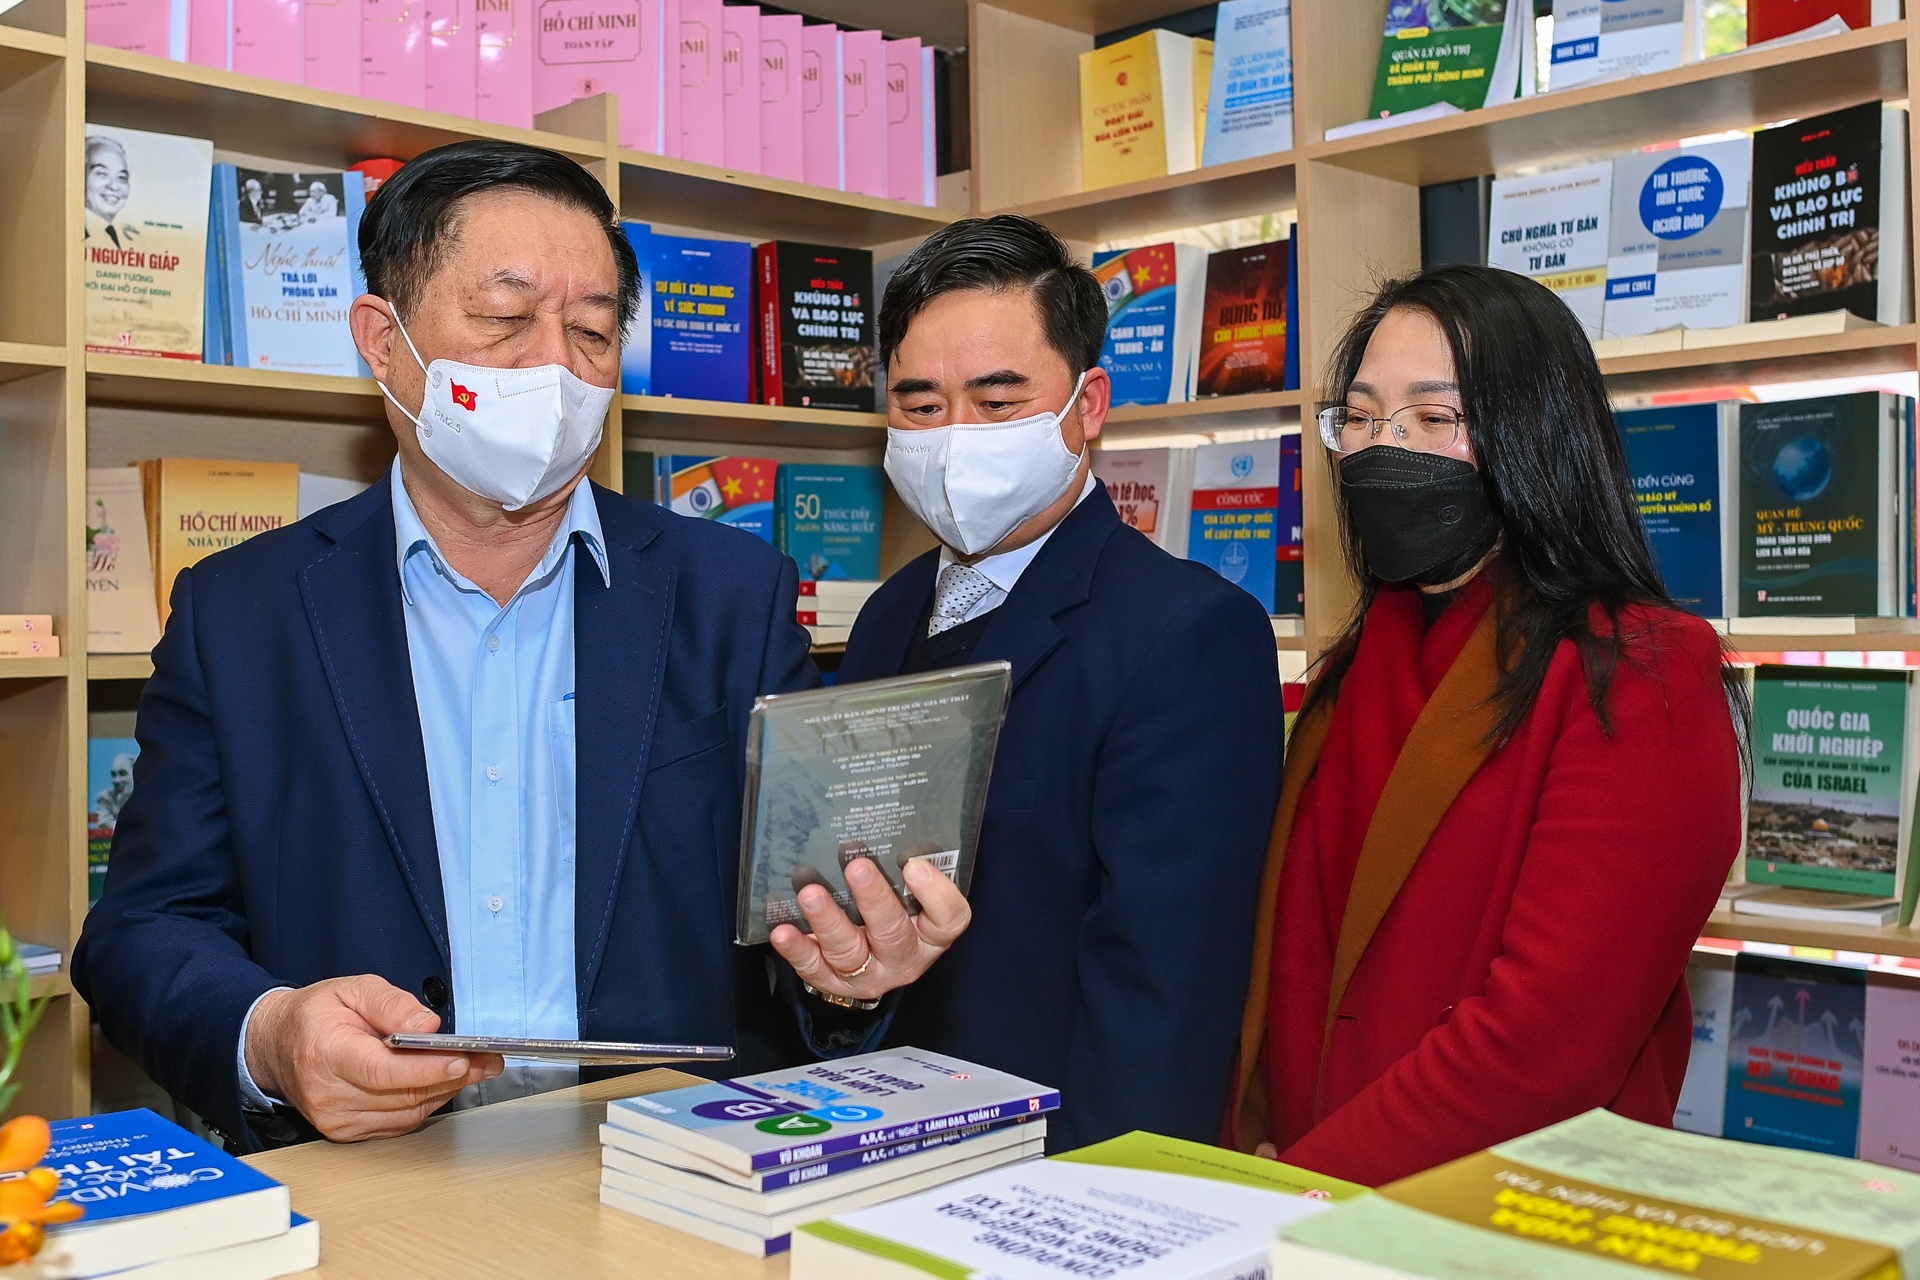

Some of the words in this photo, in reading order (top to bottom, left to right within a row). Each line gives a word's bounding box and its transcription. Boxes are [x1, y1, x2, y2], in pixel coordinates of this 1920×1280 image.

[543, 10, 563, 32] HỒ
[568, 11, 594, 30] CHÍ
[599, 14, 636, 28] MINH
[564, 40, 591, 50] TOÀN
[595, 38, 614, 49] TẬP
[1391, 46, 1420, 62] QUẢN
[1420, 45, 1435, 59] LÝ
[1435, 43, 1452, 57] ĐÔ
[1453, 43, 1471, 57] THỊ
[1402, 59, 1425, 73] QUẢN
[1387, 74, 1414, 86] THÀNH
[1415, 70, 1432, 84] PHỐ
[1433, 69, 1461, 83] THÔNG
[1462, 68, 1485, 80] MINH
[1653, 171, 1669, 190] THỊ
[1774, 172, 1831, 201] KHỦNG
[1836, 163, 1859, 185] BỐ
[1770, 200, 1792, 222] VÀ
[1796, 194, 1828, 217] BẠO
[1832, 186, 1863, 210] LỰC
[1501, 226, 1522, 244] CHỦ
[1525, 222, 1557, 241] NGHĨA
[1560, 219, 1574, 235] TƯ
[1577, 214, 1598, 232] BẢN
[1776, 213, 1826, 240] CHÍNH
[1829, 209, 1855, 228] TRỊ
[1522, 240, 1556, 254] KHÔNG
[1560, 236, 1574, 249] CÓ
[91, 247, 145, 268] NGUYÊN
[149, 250, 180, 271] GIÁP
[1529, 254, 1543, 271] TƯ
[1545, 251, 1566, 269] BẢN
[96, 270, 121, 279] DANH
[281, 271, 299, 283] TRẢ
[118, 281, 130, 293] HỒ
[132, 284, 148, 295] CHÍ
[149, 288, 171, 297] MINH
[282, 285, 315, 298] PHỎNG
[318, 285, 338, 298] VẤN
[794, 290, 841, 306] KHỦNG
[843, 292, 860, 308] BỐ
[250, 304, 272, 319] HỒ
[275, 307, 302, 321] CHÍ
[306, 310, 348, 322] MINH
[792, 305, 810, 321] VÀ
[812, 308, 839, 324] BẠO
[841, 310, 864, 325] LỰC
[798, 322, 838, 339] CHÍNH
[840, 326, 860, 342] TRỊ
[434, 408, 462, 434] PM2.5
[1637, 473, 1659, 489] ĐẾN
[1661, 472, 1695, 488] CÙNG
[1120, 481, 1132, 500] tế
[1216, 493, 1243, 506] CÔNG
[794, 494, 821, 520] 50
[1668, 501, 1697, 513] KHỦNG
[1699, 498, 1712, 512] BỐ
[1756, 509, 1785, 521] QUAN
[1788, 506, 1801, 519] HỆ
[179, 511, 206, 532] HỒ
[208, 511, 237, 532] CHÍ
[240, 515, 283, 532] MINH
[1756, 520, 1775, 535] MỸ
[1783, 519, 1826, 532] TRUNG
[1828, 515, 1864, 531] QUỐC
[187, 534, 213, 547] NHÀ
[1786, 704, 1835, 731] QUỐC
[1840, 712, 1871, 732] GIA
[1772, 730, 1814, 754] KHỞI
[1819, 734, 1884, 760] NGHIỆP
[1783, 768, 1813, 790] CỦA
[1817, 775, 1868, 794] ISRAEL
[1788, 1067, 1841, 1092] TRUNG
[724, 1101, 775, 1117] B
[831, 1107, 868, 1119] C
[776, 1116, 820, 1130] A
[780, 1149, 791, 1165] VŨ
[792, 1144, 822, 1162] KHOAN
[859, 1130, 886, 1146] A,B,C,
[925, 1116, 947, 1132] LÃNH
[948, 1112, 967, 1129] ĐẠO,
[968, 1107, 989, 1124] QUẢN
[990, 1105, 1001, 1118] LÝ
[789, 1168, 800, 1184] VŨ
[801, 1162, 828, 1182] KHOAN
